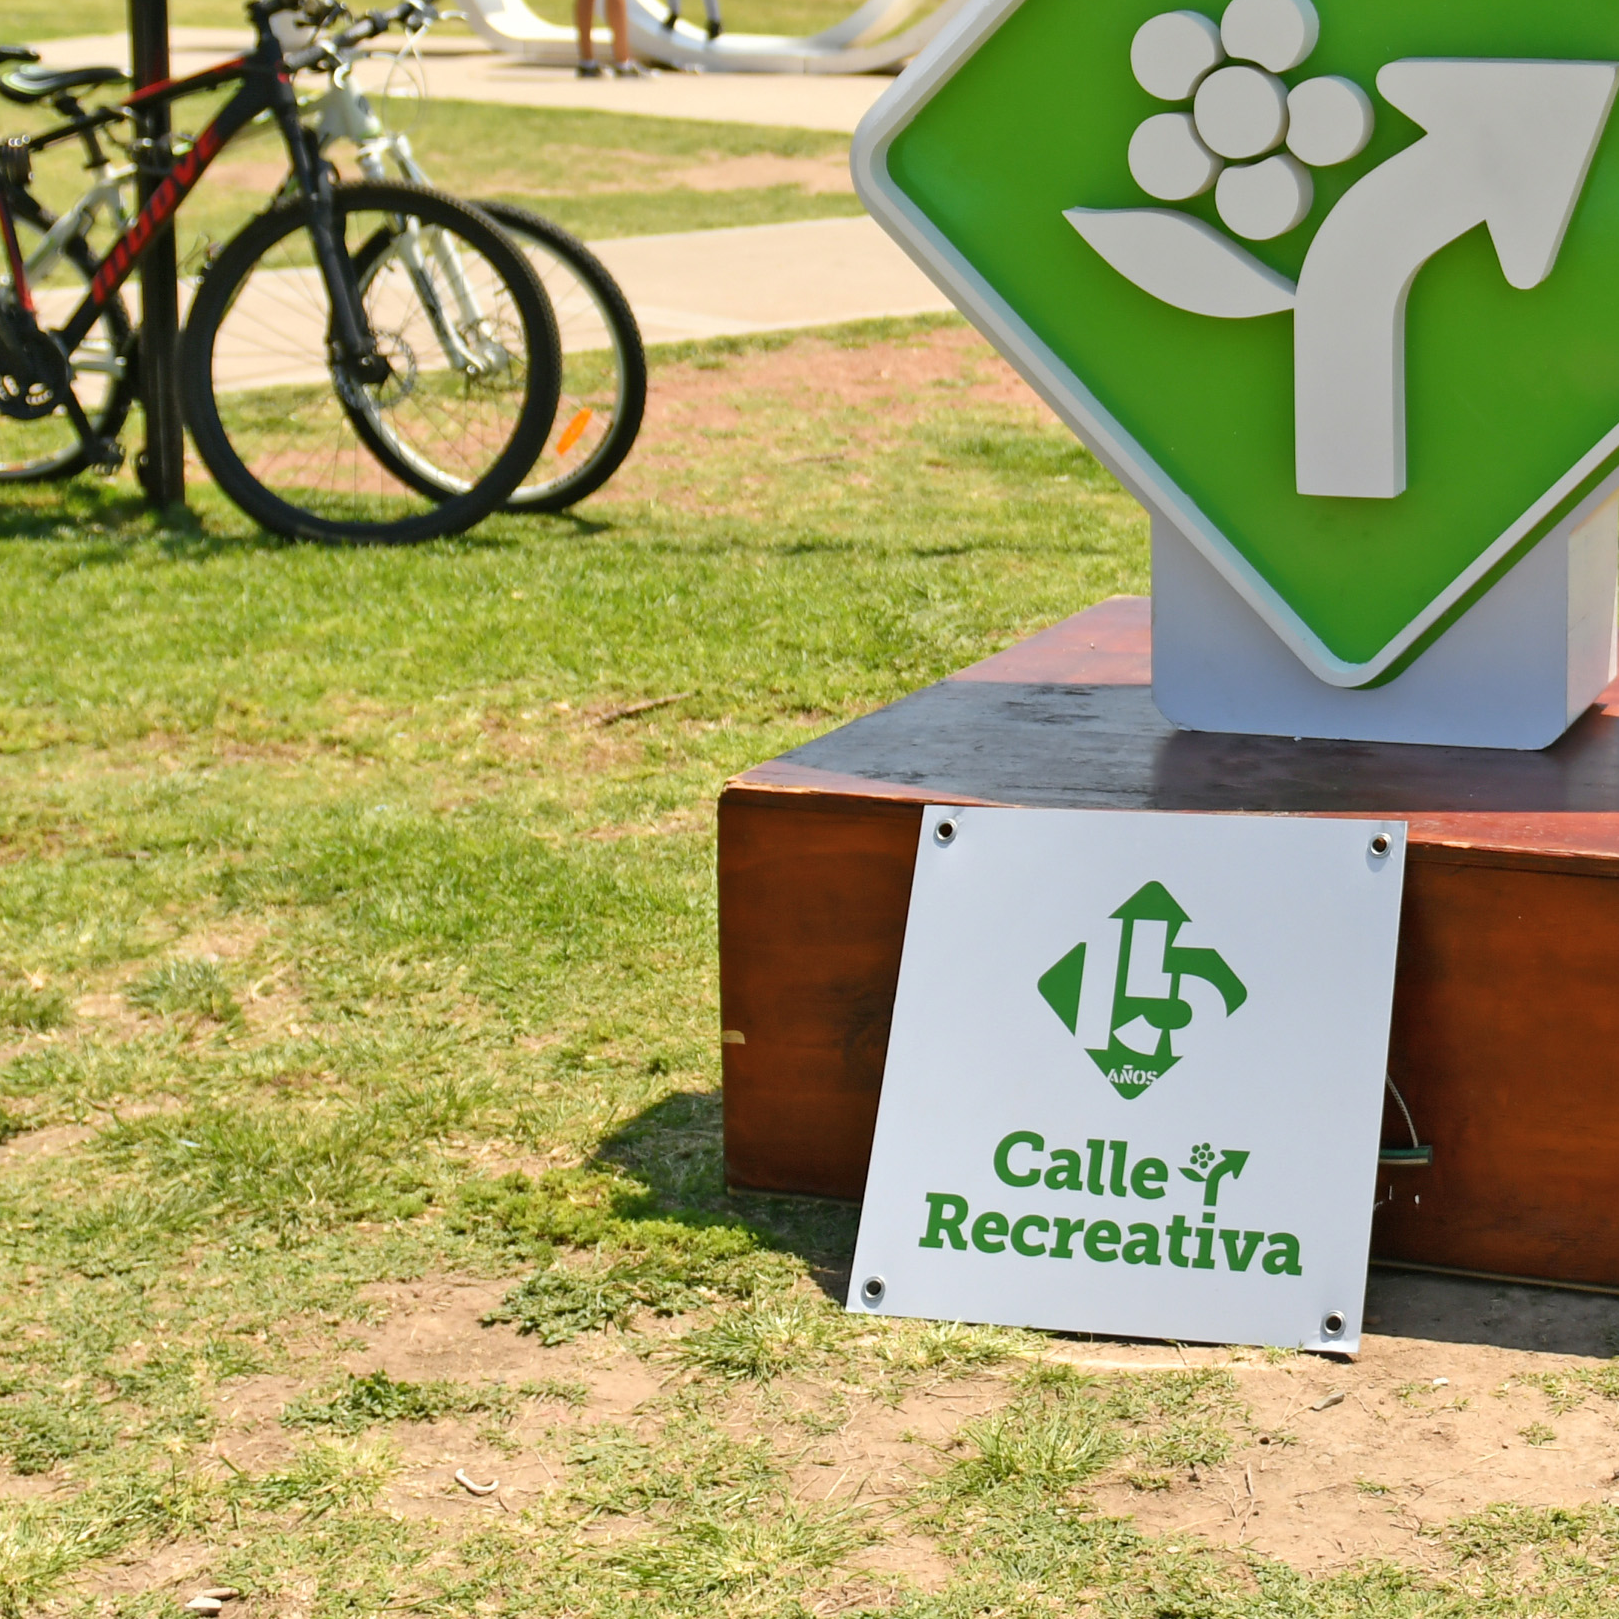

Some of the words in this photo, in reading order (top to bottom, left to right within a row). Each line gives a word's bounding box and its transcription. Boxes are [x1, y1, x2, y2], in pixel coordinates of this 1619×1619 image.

[1107, 1064, 1159, 1086] AÑOS
[993, 1130, 1170, 1200] Calle
[919, 1192, 1303, 1277] Recreativa
